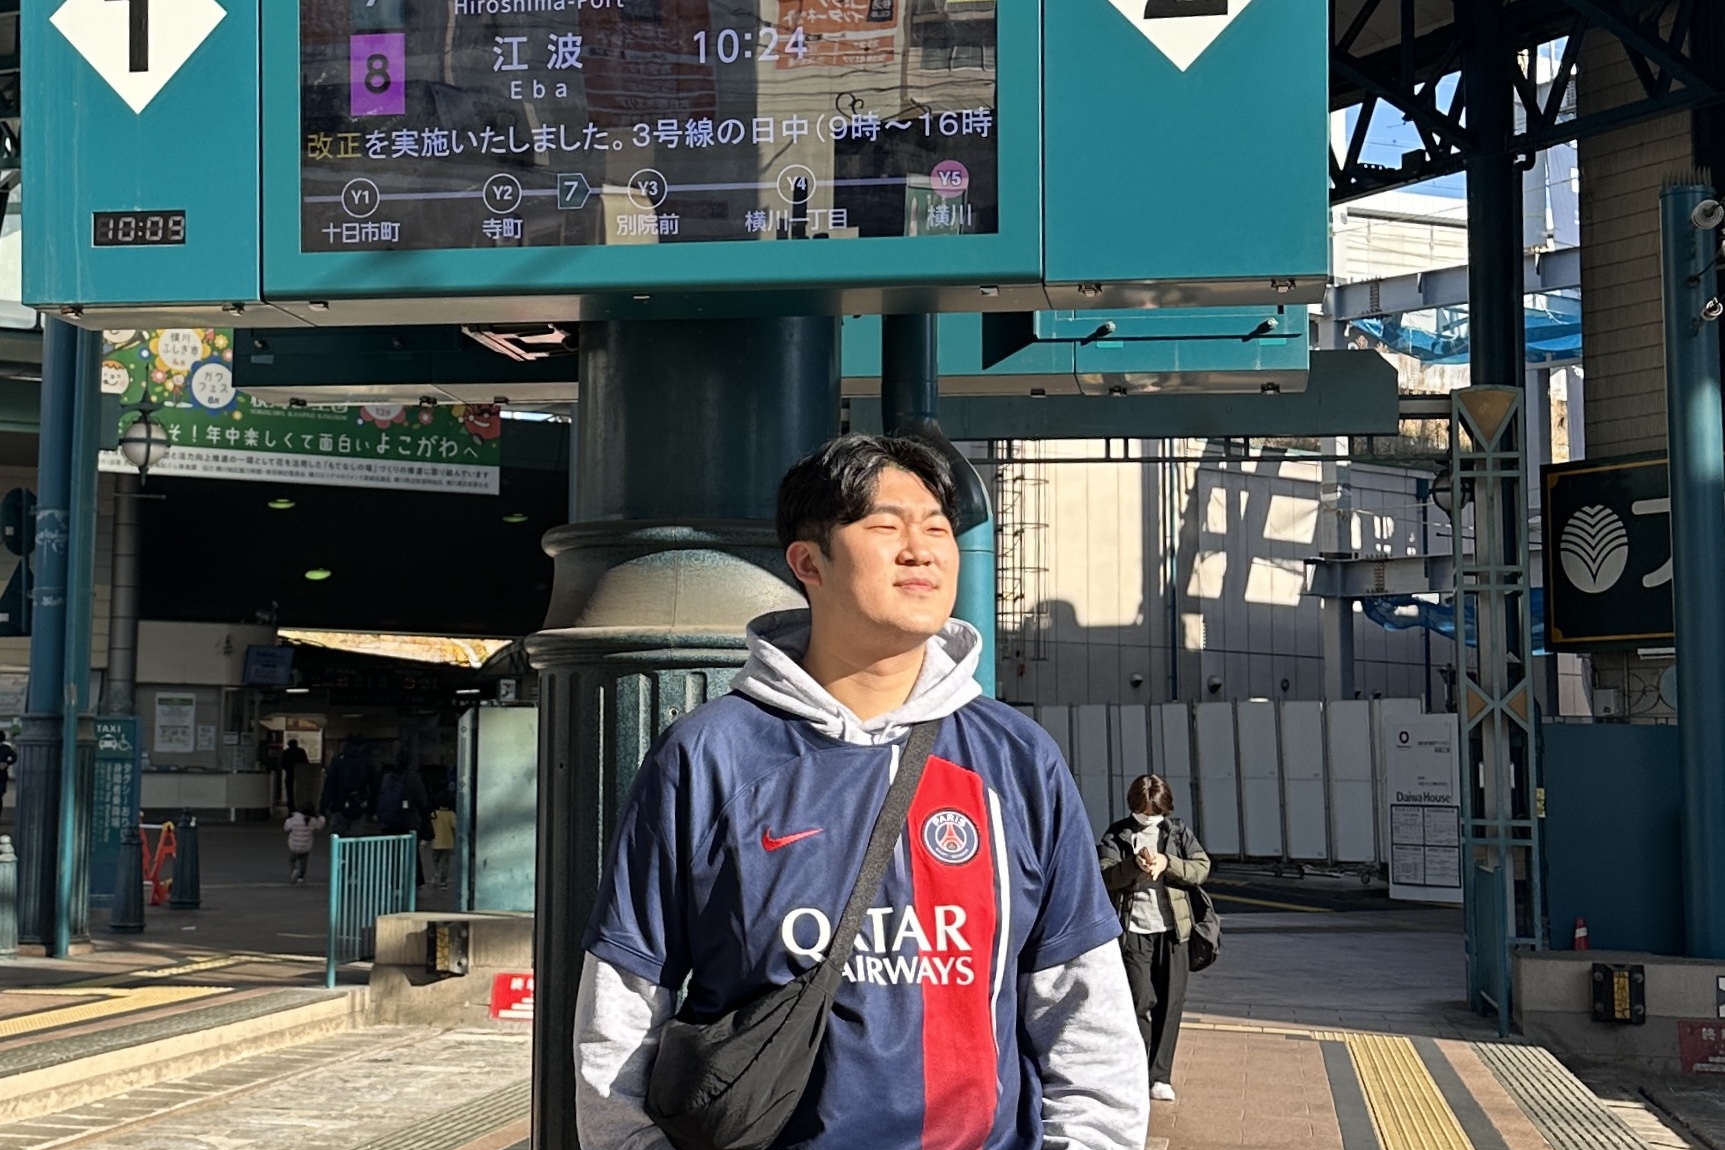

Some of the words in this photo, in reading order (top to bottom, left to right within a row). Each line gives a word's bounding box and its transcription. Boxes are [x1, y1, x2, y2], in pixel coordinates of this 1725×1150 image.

[493, 32, 583, 72] 江波
[693, 26, 807, 64] 10:24
[364, 53, 391, 94] 8
[510, 80, 568, 100] Eba
[637, 180, 659, 196] Y3
[786, 175, 807, 191] Y4
[938, 170, 962, 186] Y5
[351, 189, 371, 205] Y1
[492, 185, 514, 201] Y2
[563, 181, 580, 202] 7
[616, 212, 680, 236] 別院前
[745, 207, 848, 234] 横川一丁目
[927, 203, 973, 228] 横川
[107, 215, 185, 241] 10:09
[321, 221, 400, 243] 十日市町
[482, 217, 524, 240] 寺町
[96, 724, 122, 733] TAXI
[1396, 790, 1422, 802] Daiwa
[1423, 792, 1451, 803] House
[931, 813, 967, 827] PARIS
[781, 905, 973, 962] QTAR
